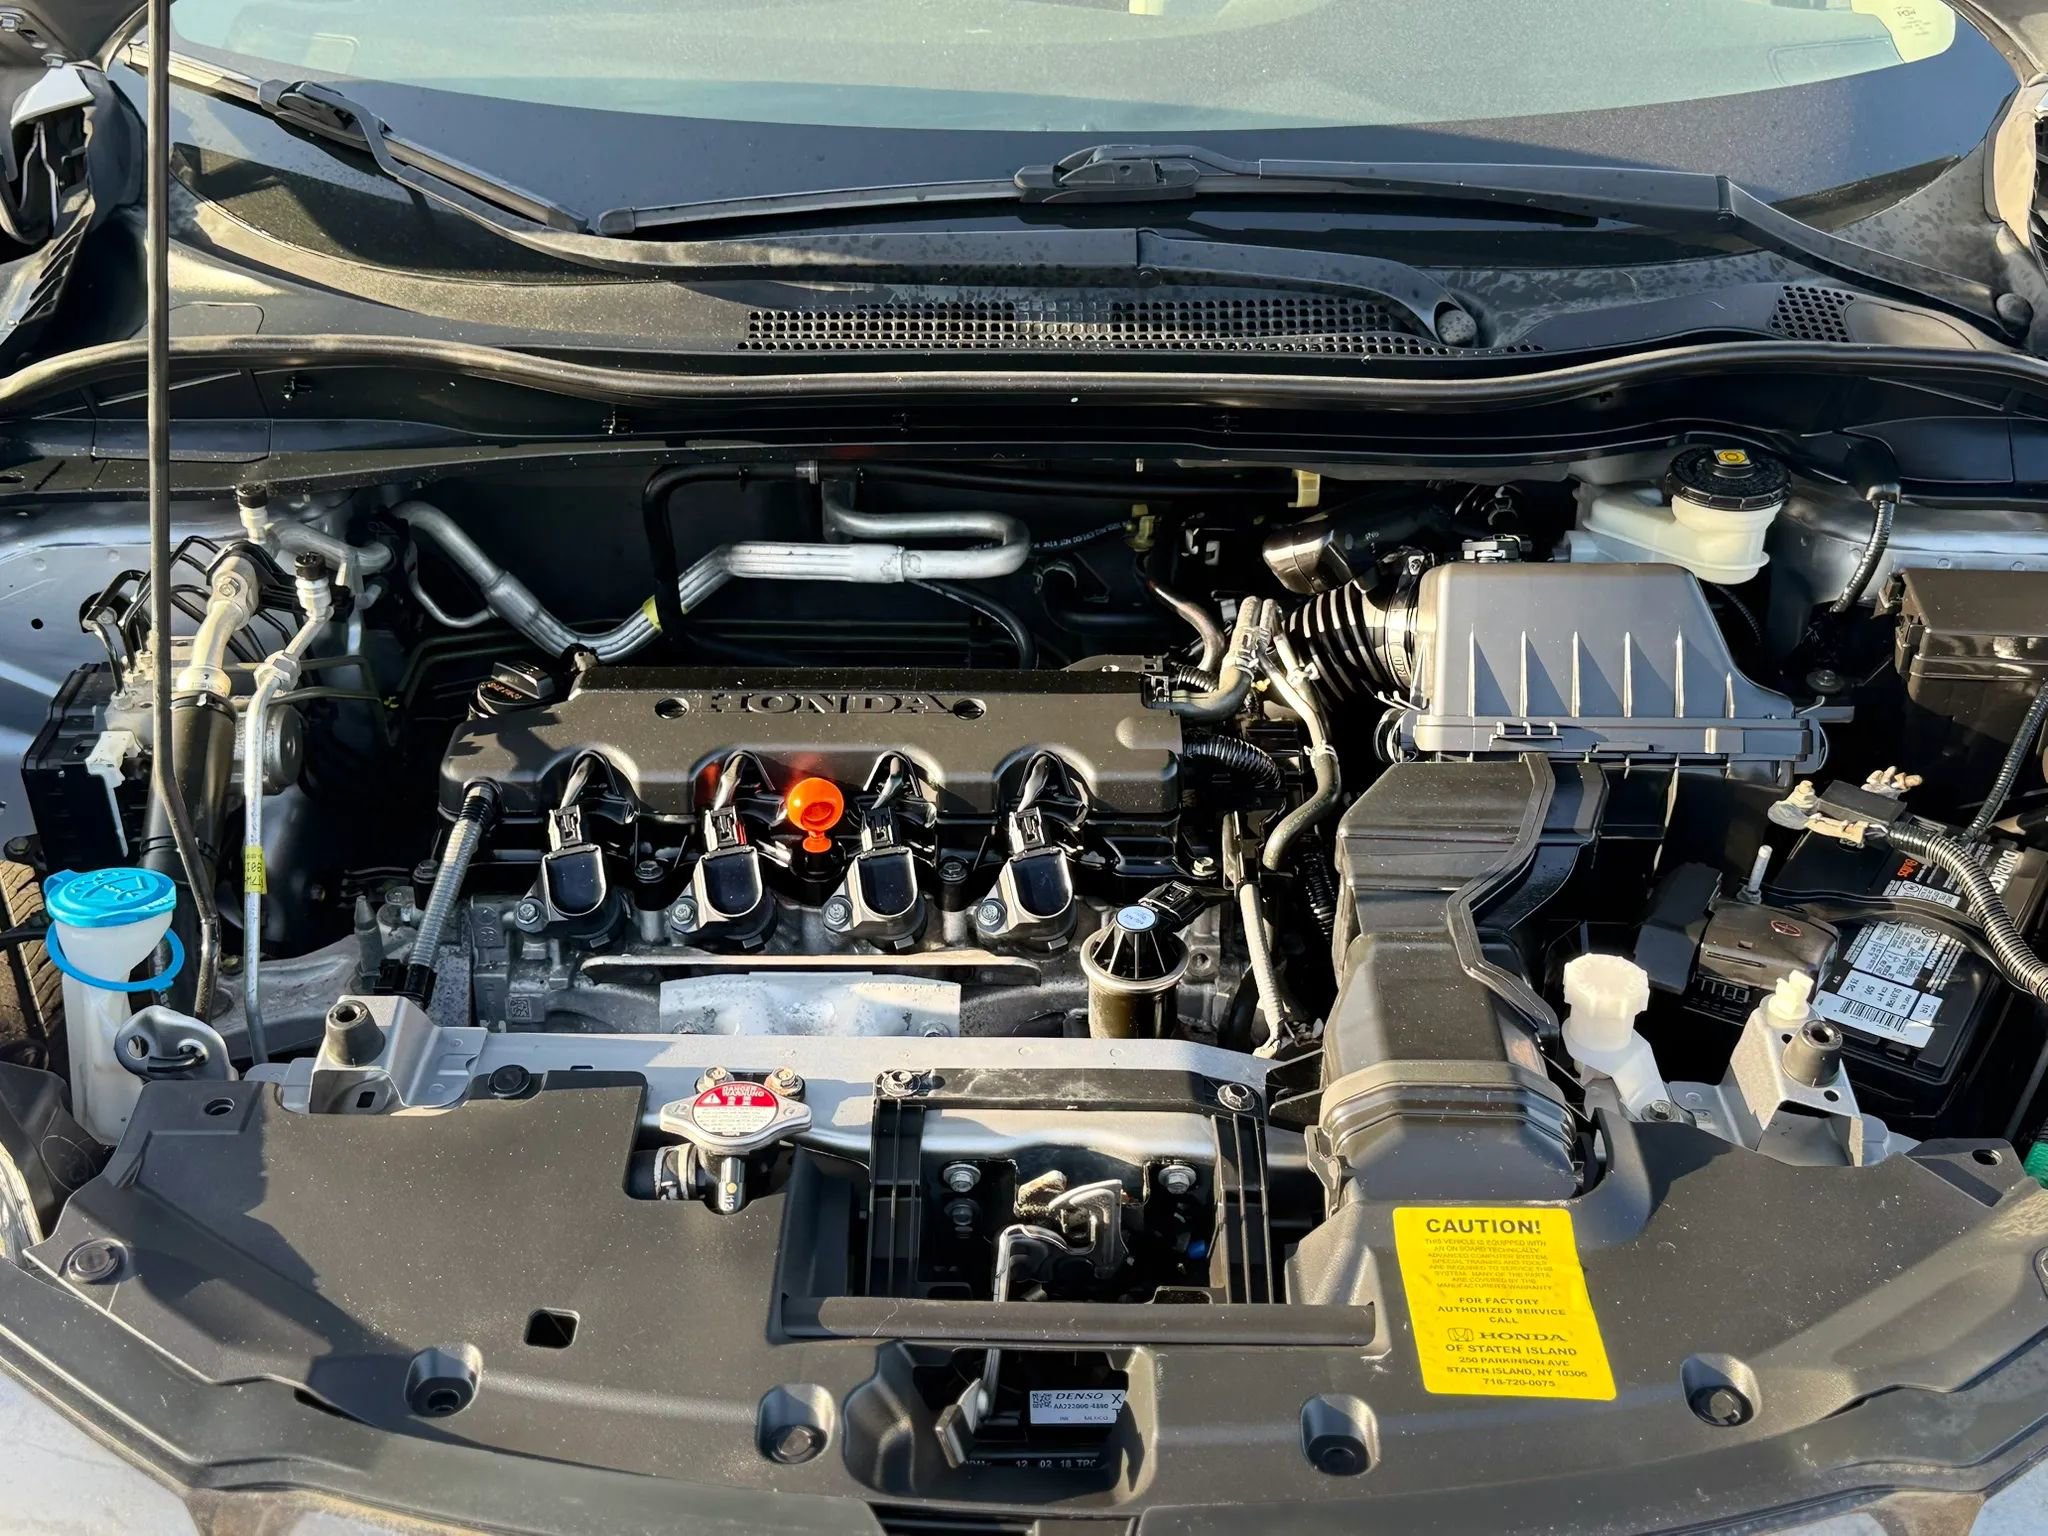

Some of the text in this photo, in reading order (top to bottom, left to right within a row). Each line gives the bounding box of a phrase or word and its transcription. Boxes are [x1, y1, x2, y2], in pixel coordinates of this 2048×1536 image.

[692, 692, 953, 714] HONDA
[1988, 850, 2017, 894] DURACE
[1426, 1218, 1542, 1234] CAUTION!
[1485, 1297, 1539, 1305] FACTORY
[1437, 1305, 1566, 1316] AUTHORIZED SERVICE
[1489, 1316, 1519, 1324] CALL
[1479, 1332, 1568, 1342] HONDA
[1446, 1344, 1578, 1356] OF STATEN ISLAND
[1481, 1357, 1545, 1366] PARKINSON
[1547, 1359, 1570, 1367] AVE
[1447, 1366, 1490, 1374] STATEN
[1492, 1367, 1536, 1377] ISLAND,
[1056, 1392, 1104, 1400] DENSO
